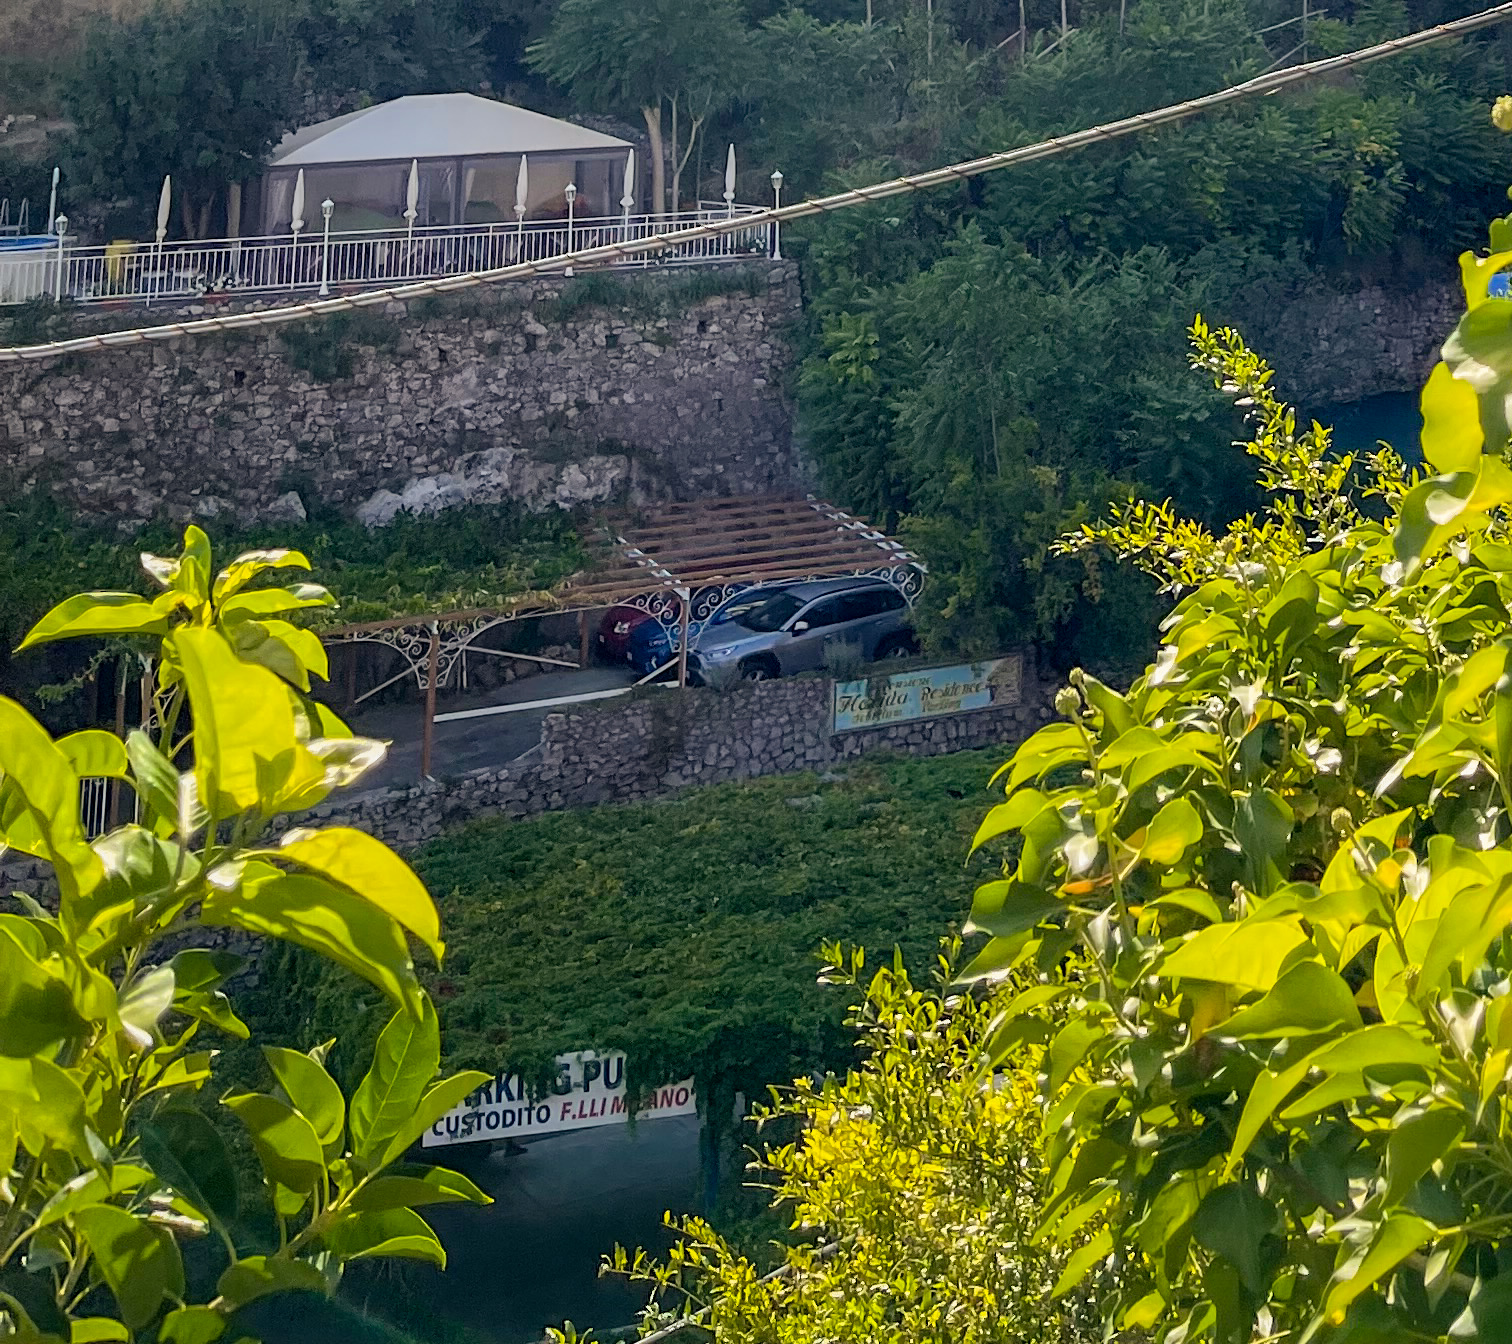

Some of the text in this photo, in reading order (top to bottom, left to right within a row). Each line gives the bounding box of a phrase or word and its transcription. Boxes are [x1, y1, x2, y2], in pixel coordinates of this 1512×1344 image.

[584, 1057, 624, 1093] PU
[432, 1087, 689, 1137] CUSTODITO F.LLI MANO
